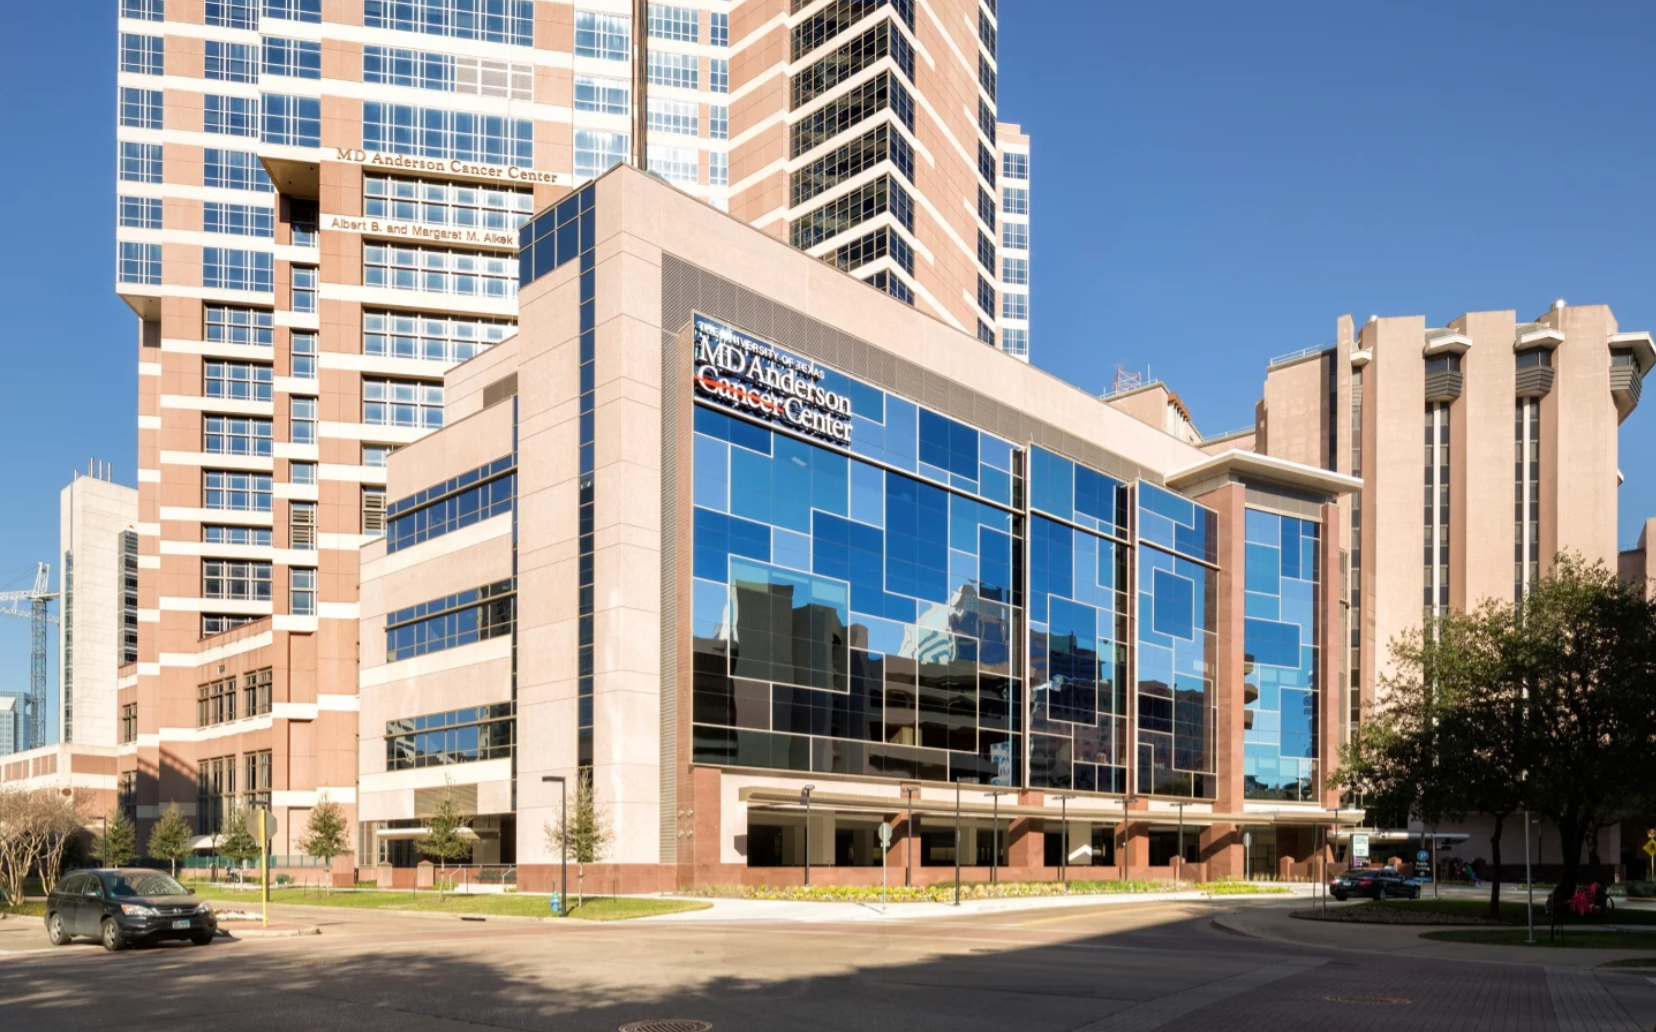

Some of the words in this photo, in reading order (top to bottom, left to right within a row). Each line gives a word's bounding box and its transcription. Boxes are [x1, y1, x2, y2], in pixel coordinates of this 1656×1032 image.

[337, 148, 366, 162] MD
[372, 153, 445, 171] Anderson
[450, 160, 503, 177] Cancer
[508, 166, 557, 183] Center
[331, 218, 367, 231] Albert
[371, 221, 382, 232] B.
[386, 225, 408, 235] and
[412, 225, 462, 240] Margaret
[466, 230, 480, 242] M.
[484, 233, 514, 245] Alkek
[697, 321, 719, 338] THE
[719, 330, 779, 358] NIVERSITY
[781, 355, 794, 366] OF
[794, 361, 825, 380] TEXAS
[699, 336, 746, 373] MD
[747, 355, 852, 417] Anderson
[698, 364, 784, 417] Cancer
[784, 396, 853, 442] Center
